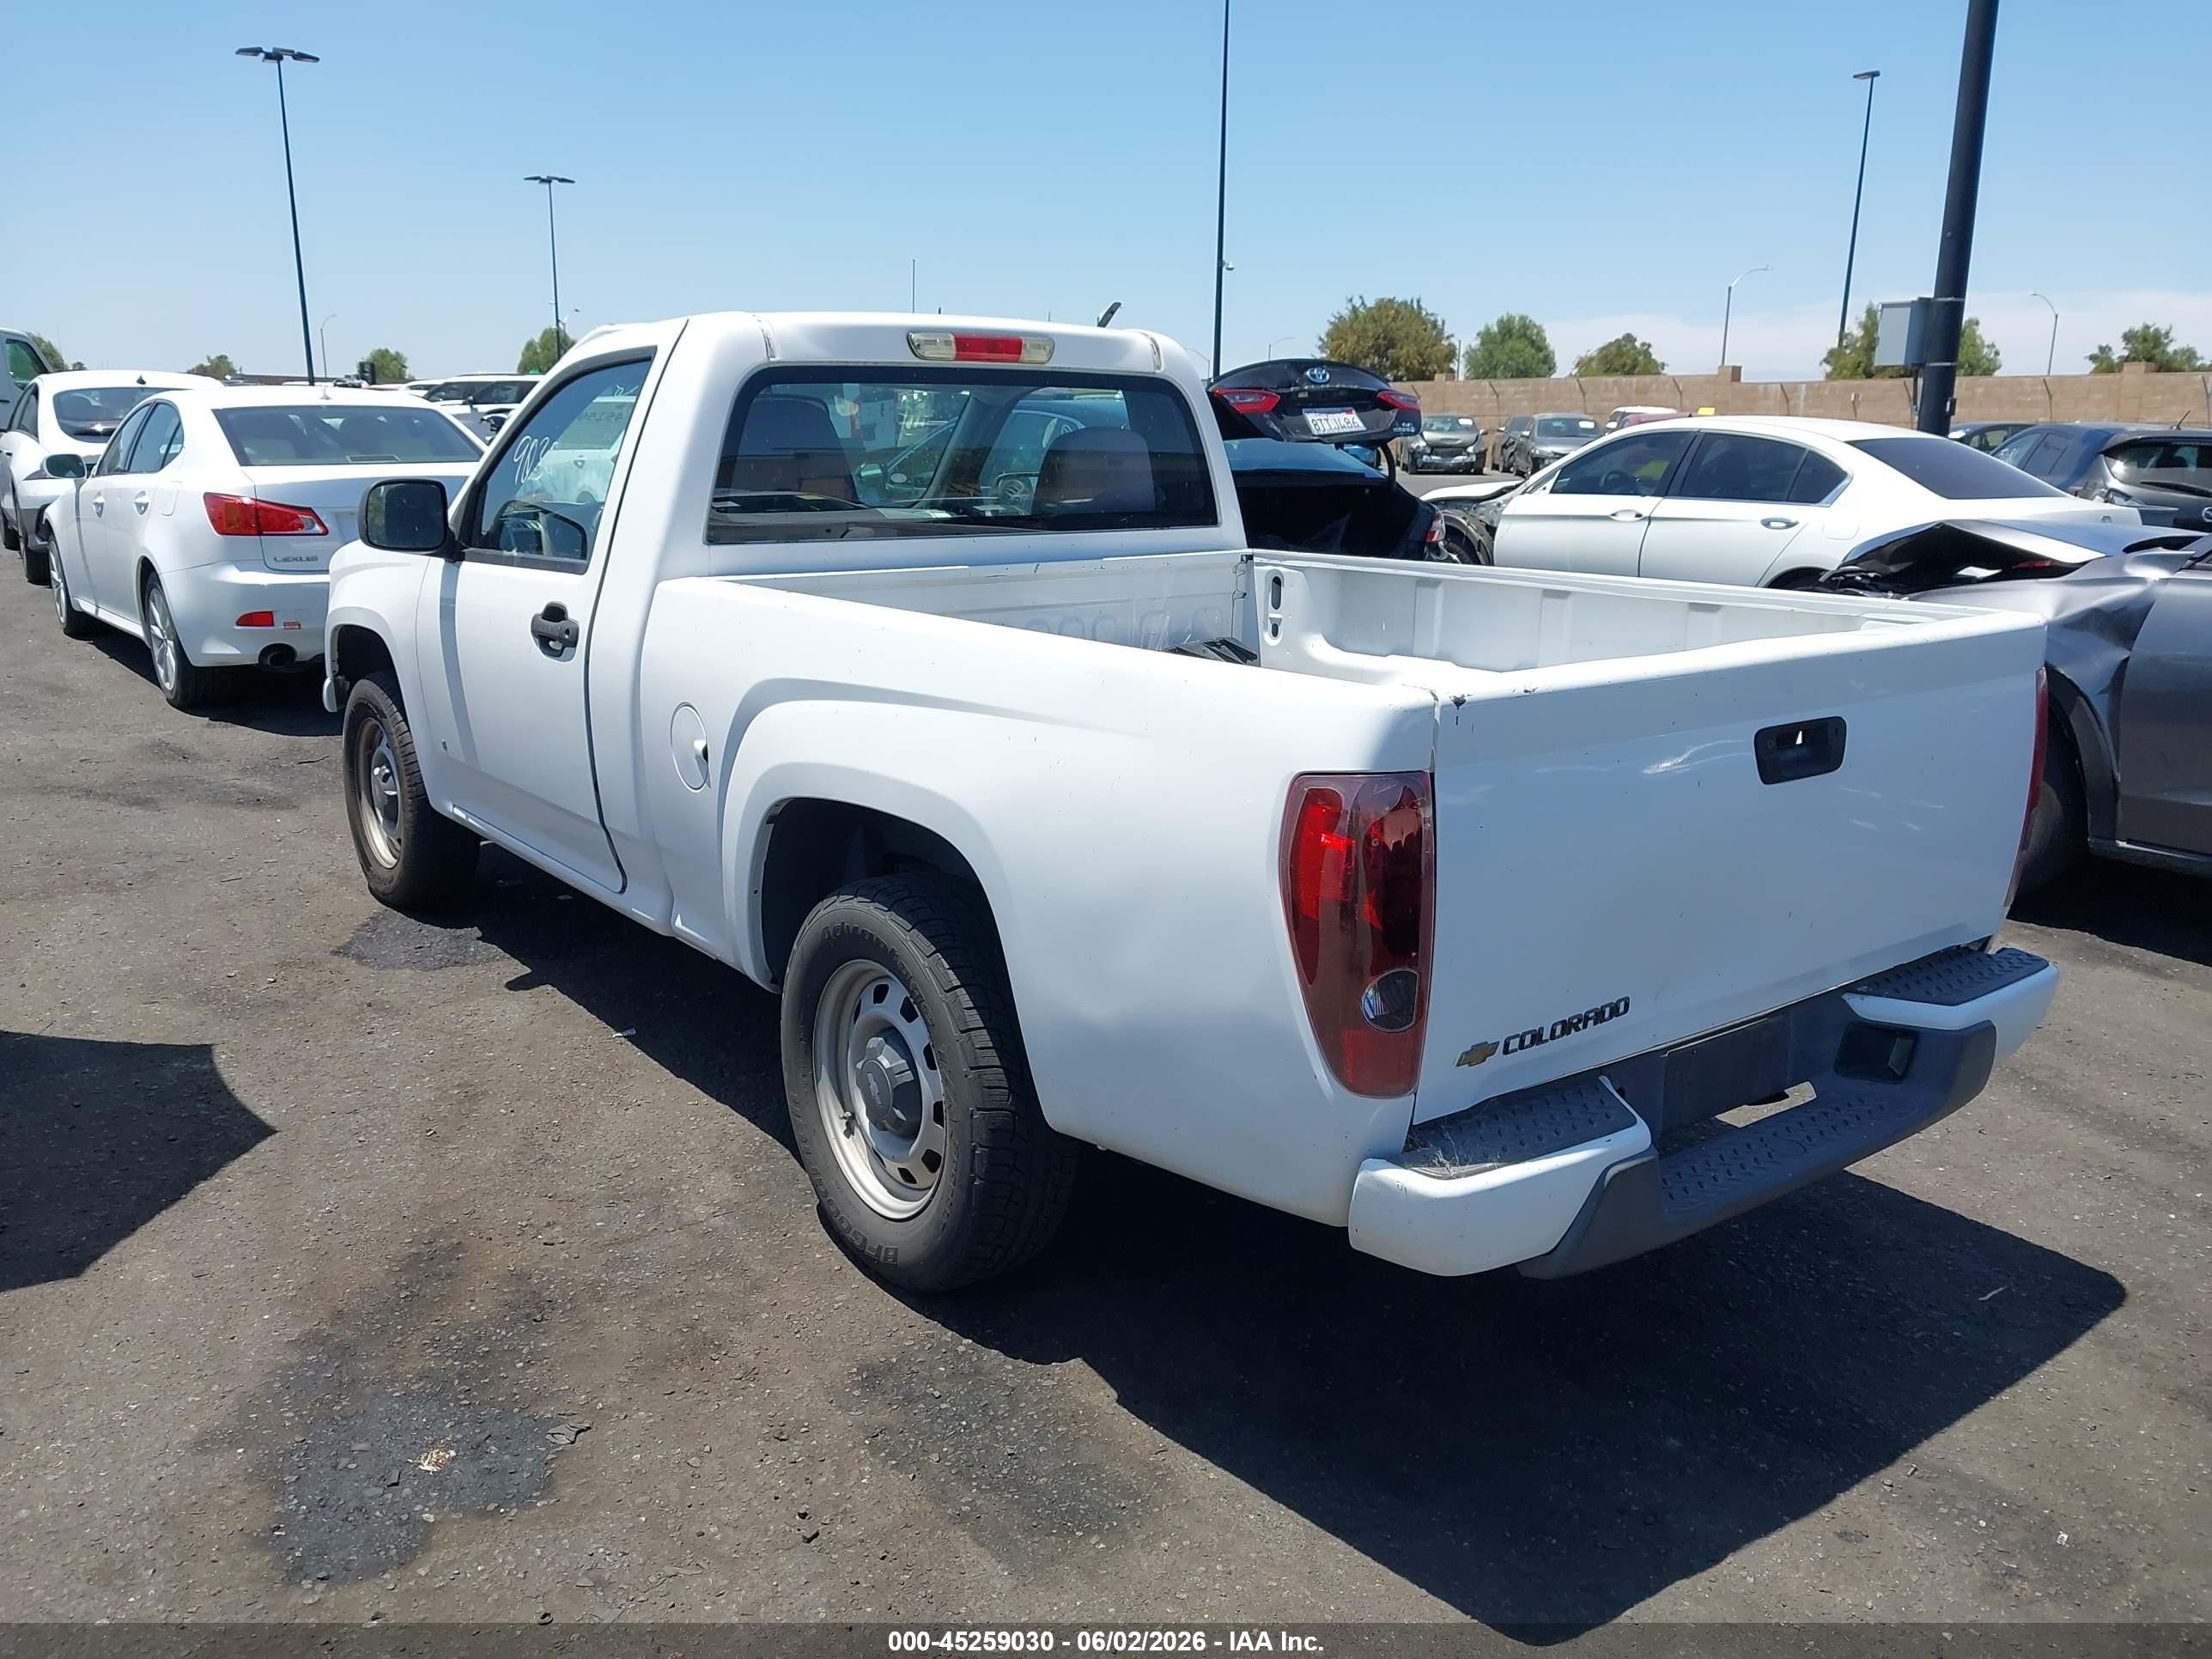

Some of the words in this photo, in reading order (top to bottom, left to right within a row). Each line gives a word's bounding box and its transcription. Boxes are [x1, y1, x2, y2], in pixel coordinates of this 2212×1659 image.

[273, 555, 319, 563] LEXUS
[821, 920, 935, 1028] Advantage
[1502, 996, 1631, 1056] COLORADO
